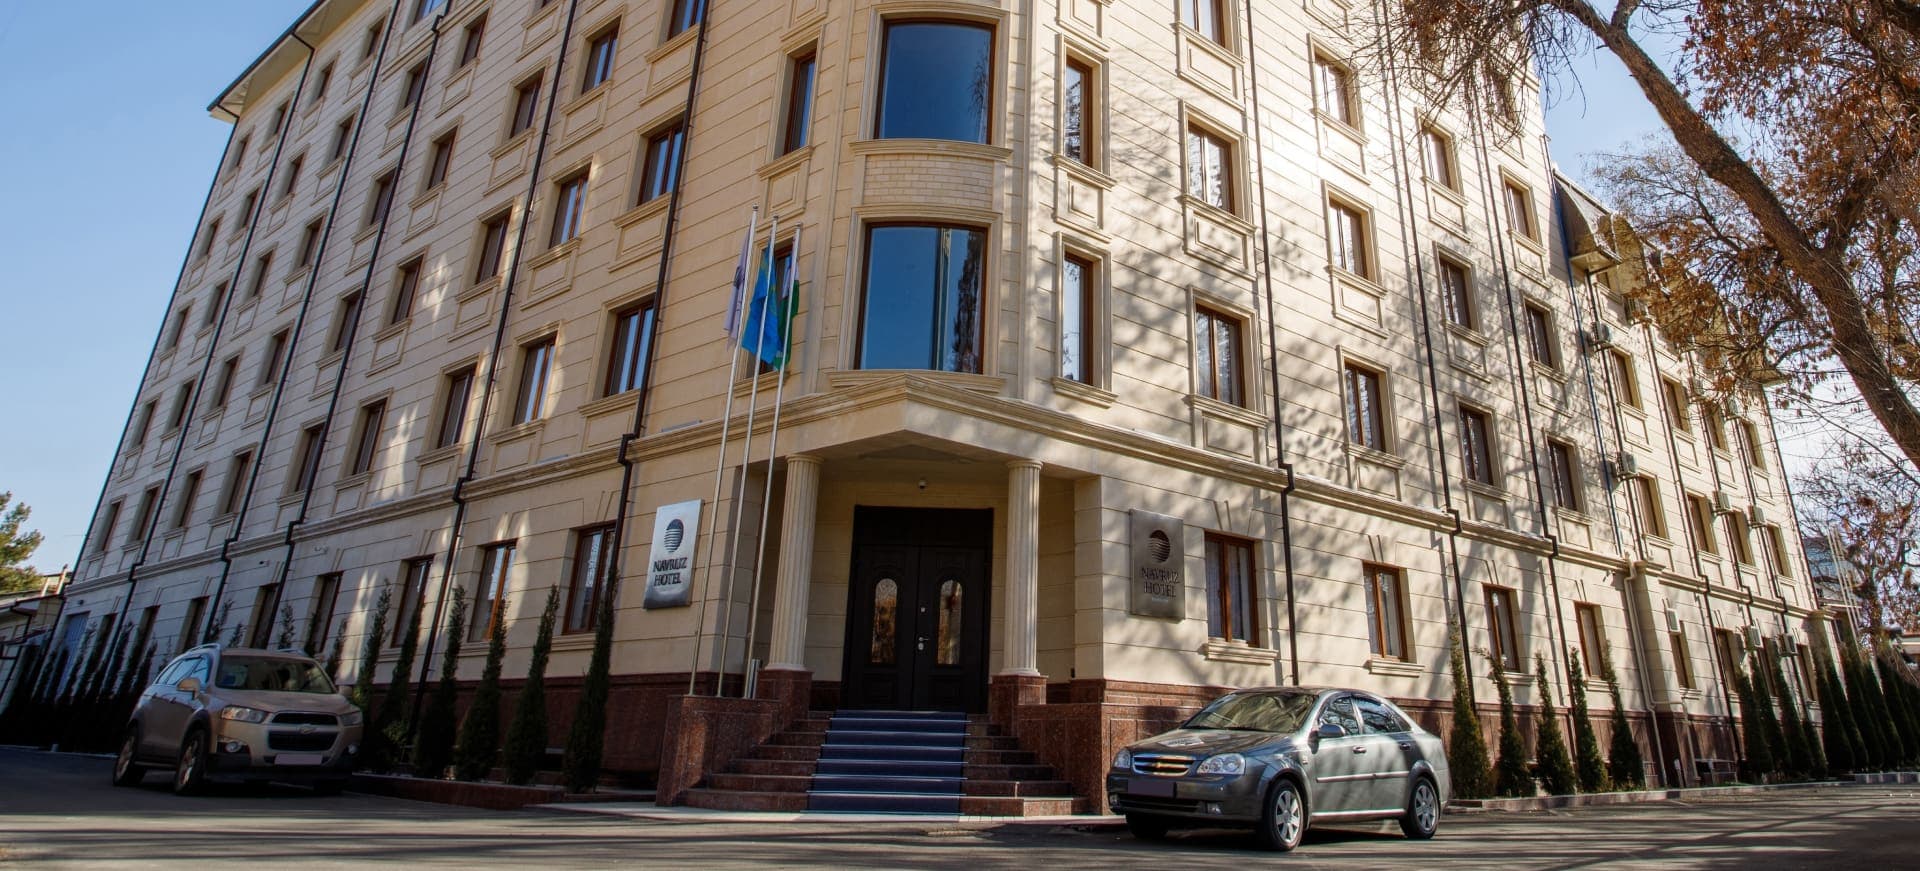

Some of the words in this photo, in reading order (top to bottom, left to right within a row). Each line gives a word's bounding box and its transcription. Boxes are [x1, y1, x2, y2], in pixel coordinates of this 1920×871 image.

[653, 557, 687, 573] NAVRUZ
[653, 572, 682, 587] HOTEL
[1141, 567, 1180, 584] NAVRUZ
[1144, 581, 1177, 598] HOTEL
